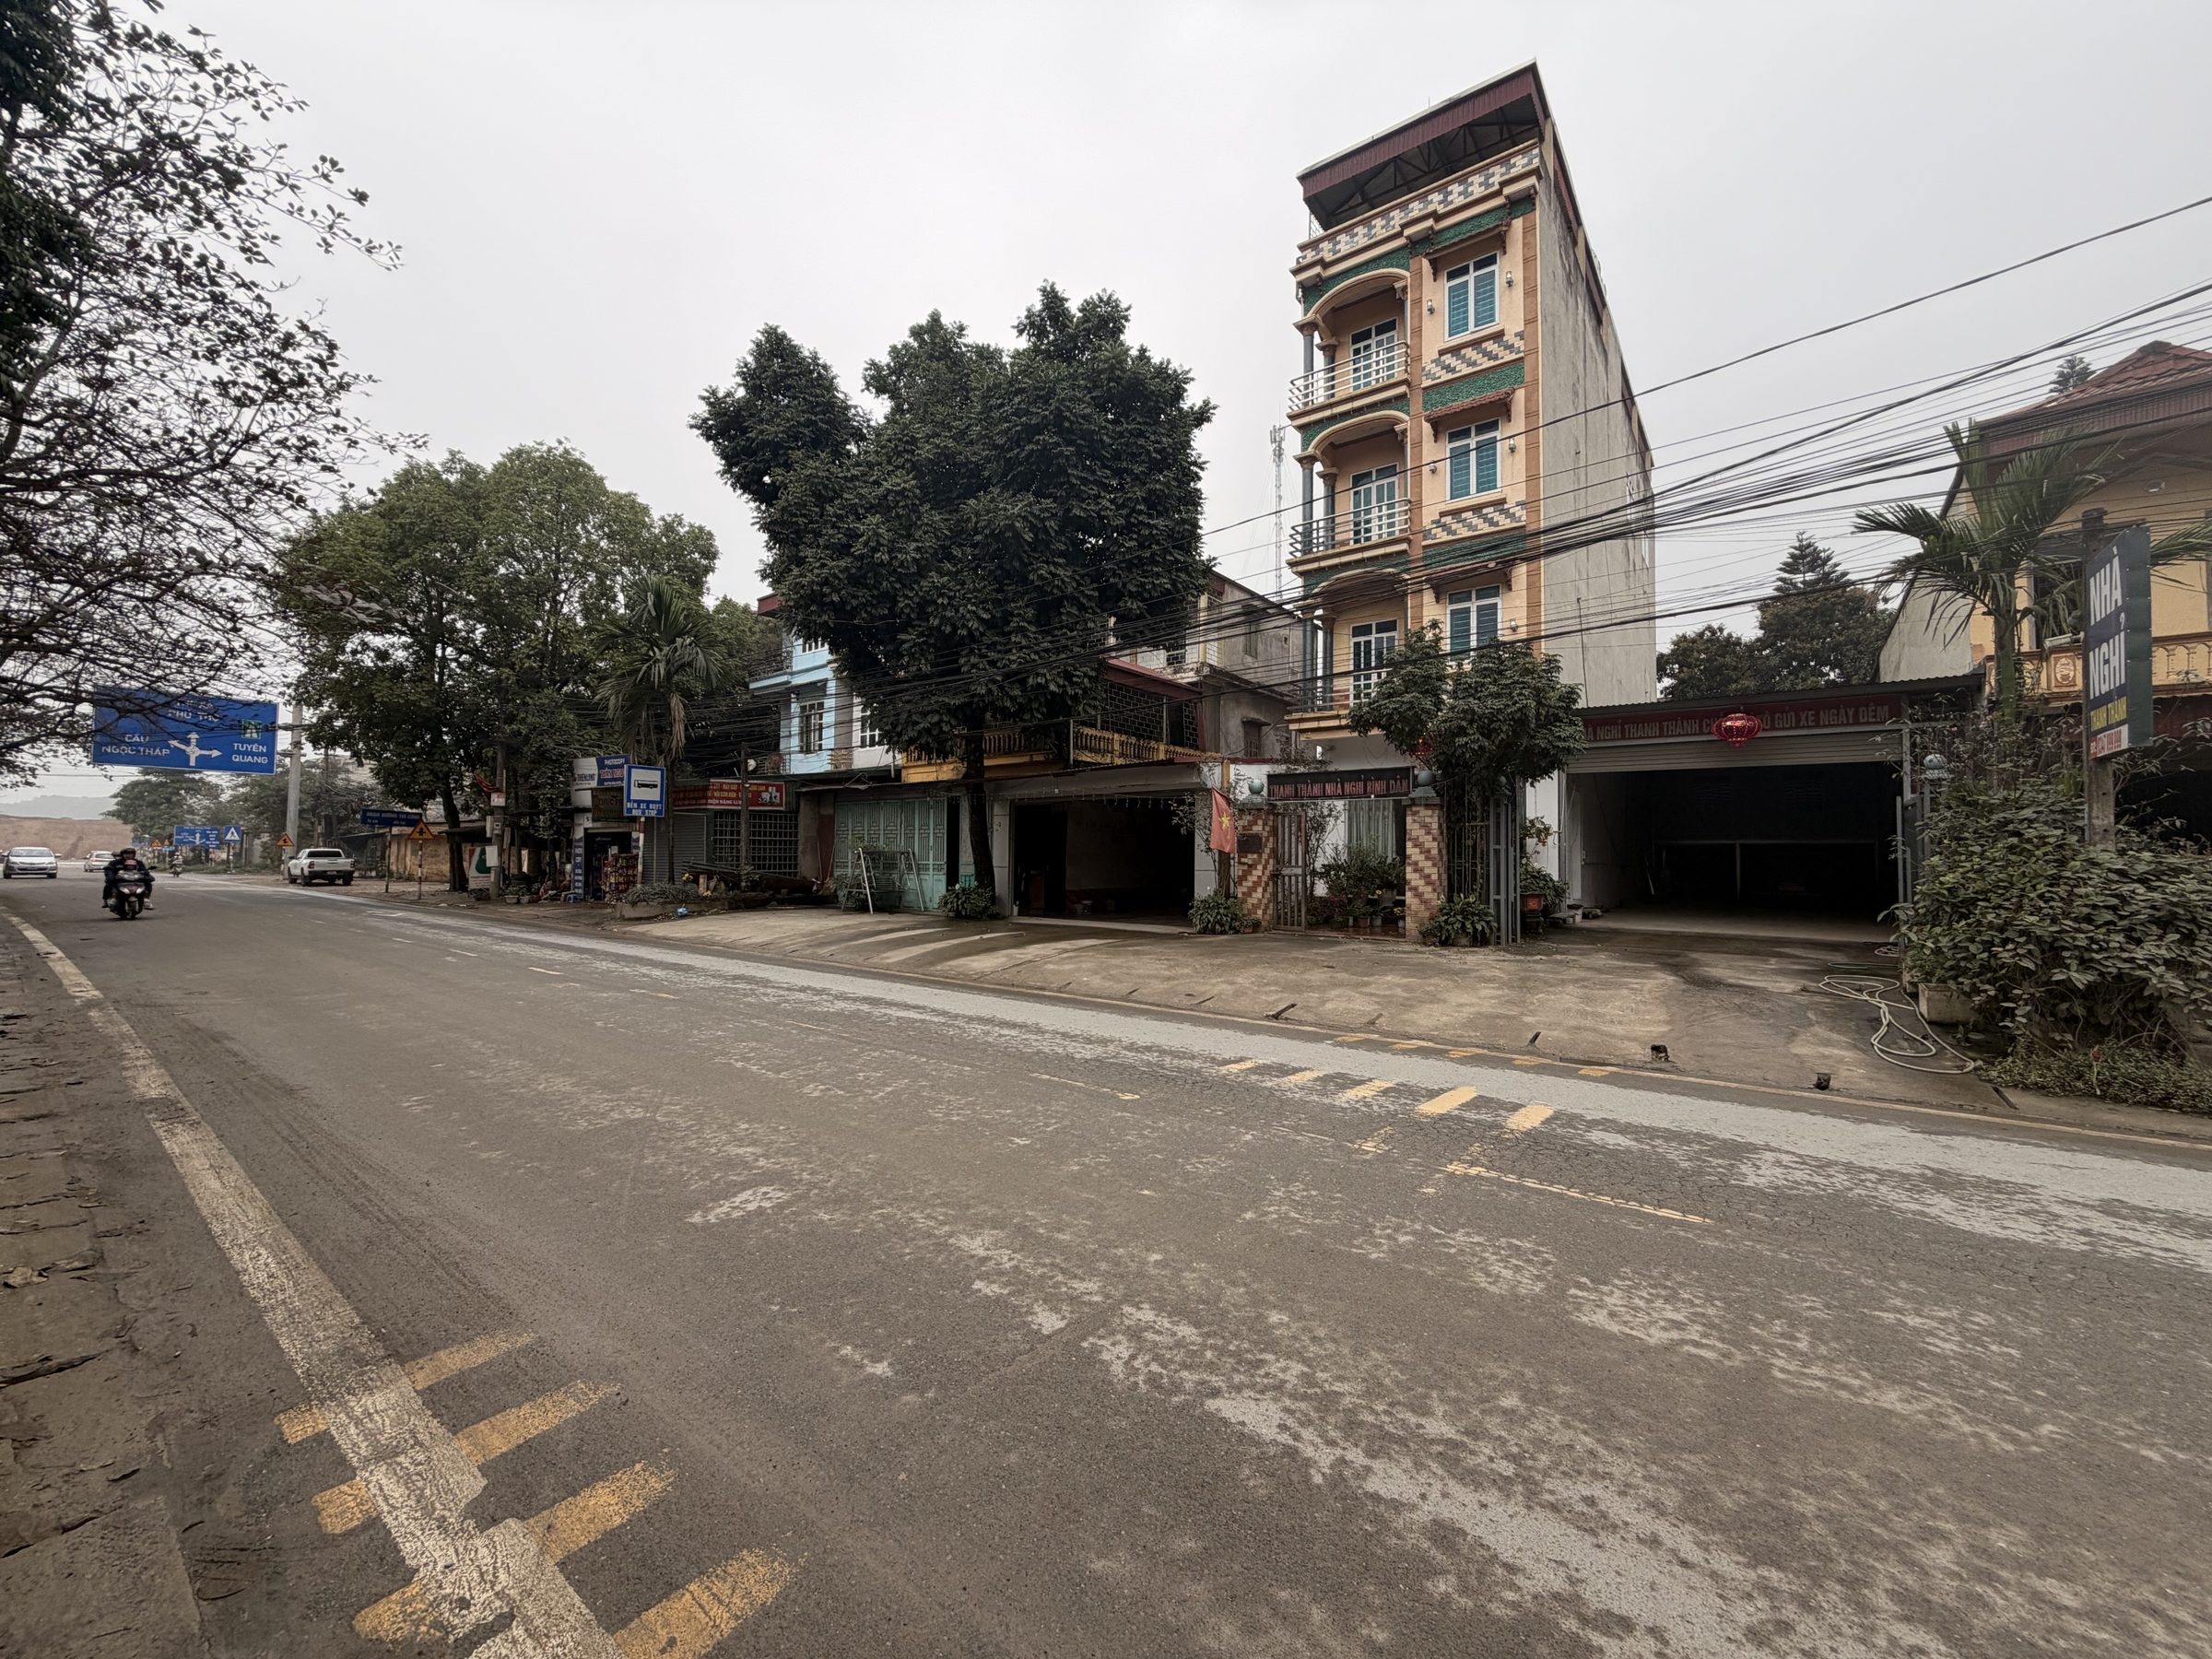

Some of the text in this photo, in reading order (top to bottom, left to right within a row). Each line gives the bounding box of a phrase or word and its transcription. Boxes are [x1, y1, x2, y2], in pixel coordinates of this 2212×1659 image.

[2088, 546, 2123, 626] NHÀ
[2088, 612, 2126, 700] NGHỈ
[1596, 719, 1622, 740] NGHỈ
[1624, 722, 1659, 737] THANH
[1663, 717, 1700, 735] THÀNH
[1799, 711, 1817, 727] XE
[1819, 704, 1854, 725] NGÀY
[1858, 702, 1889, 724] ĐÊM
[101, 745, 171, 757] NGỌC THÁP
[231, 754, 269, 764] QUANG
[232, 742, 267, 753] TUYÊN
[1269, 774, 1408, 798] THANH THÀNH NHÀ NGHỈ BÌNH DÂN
